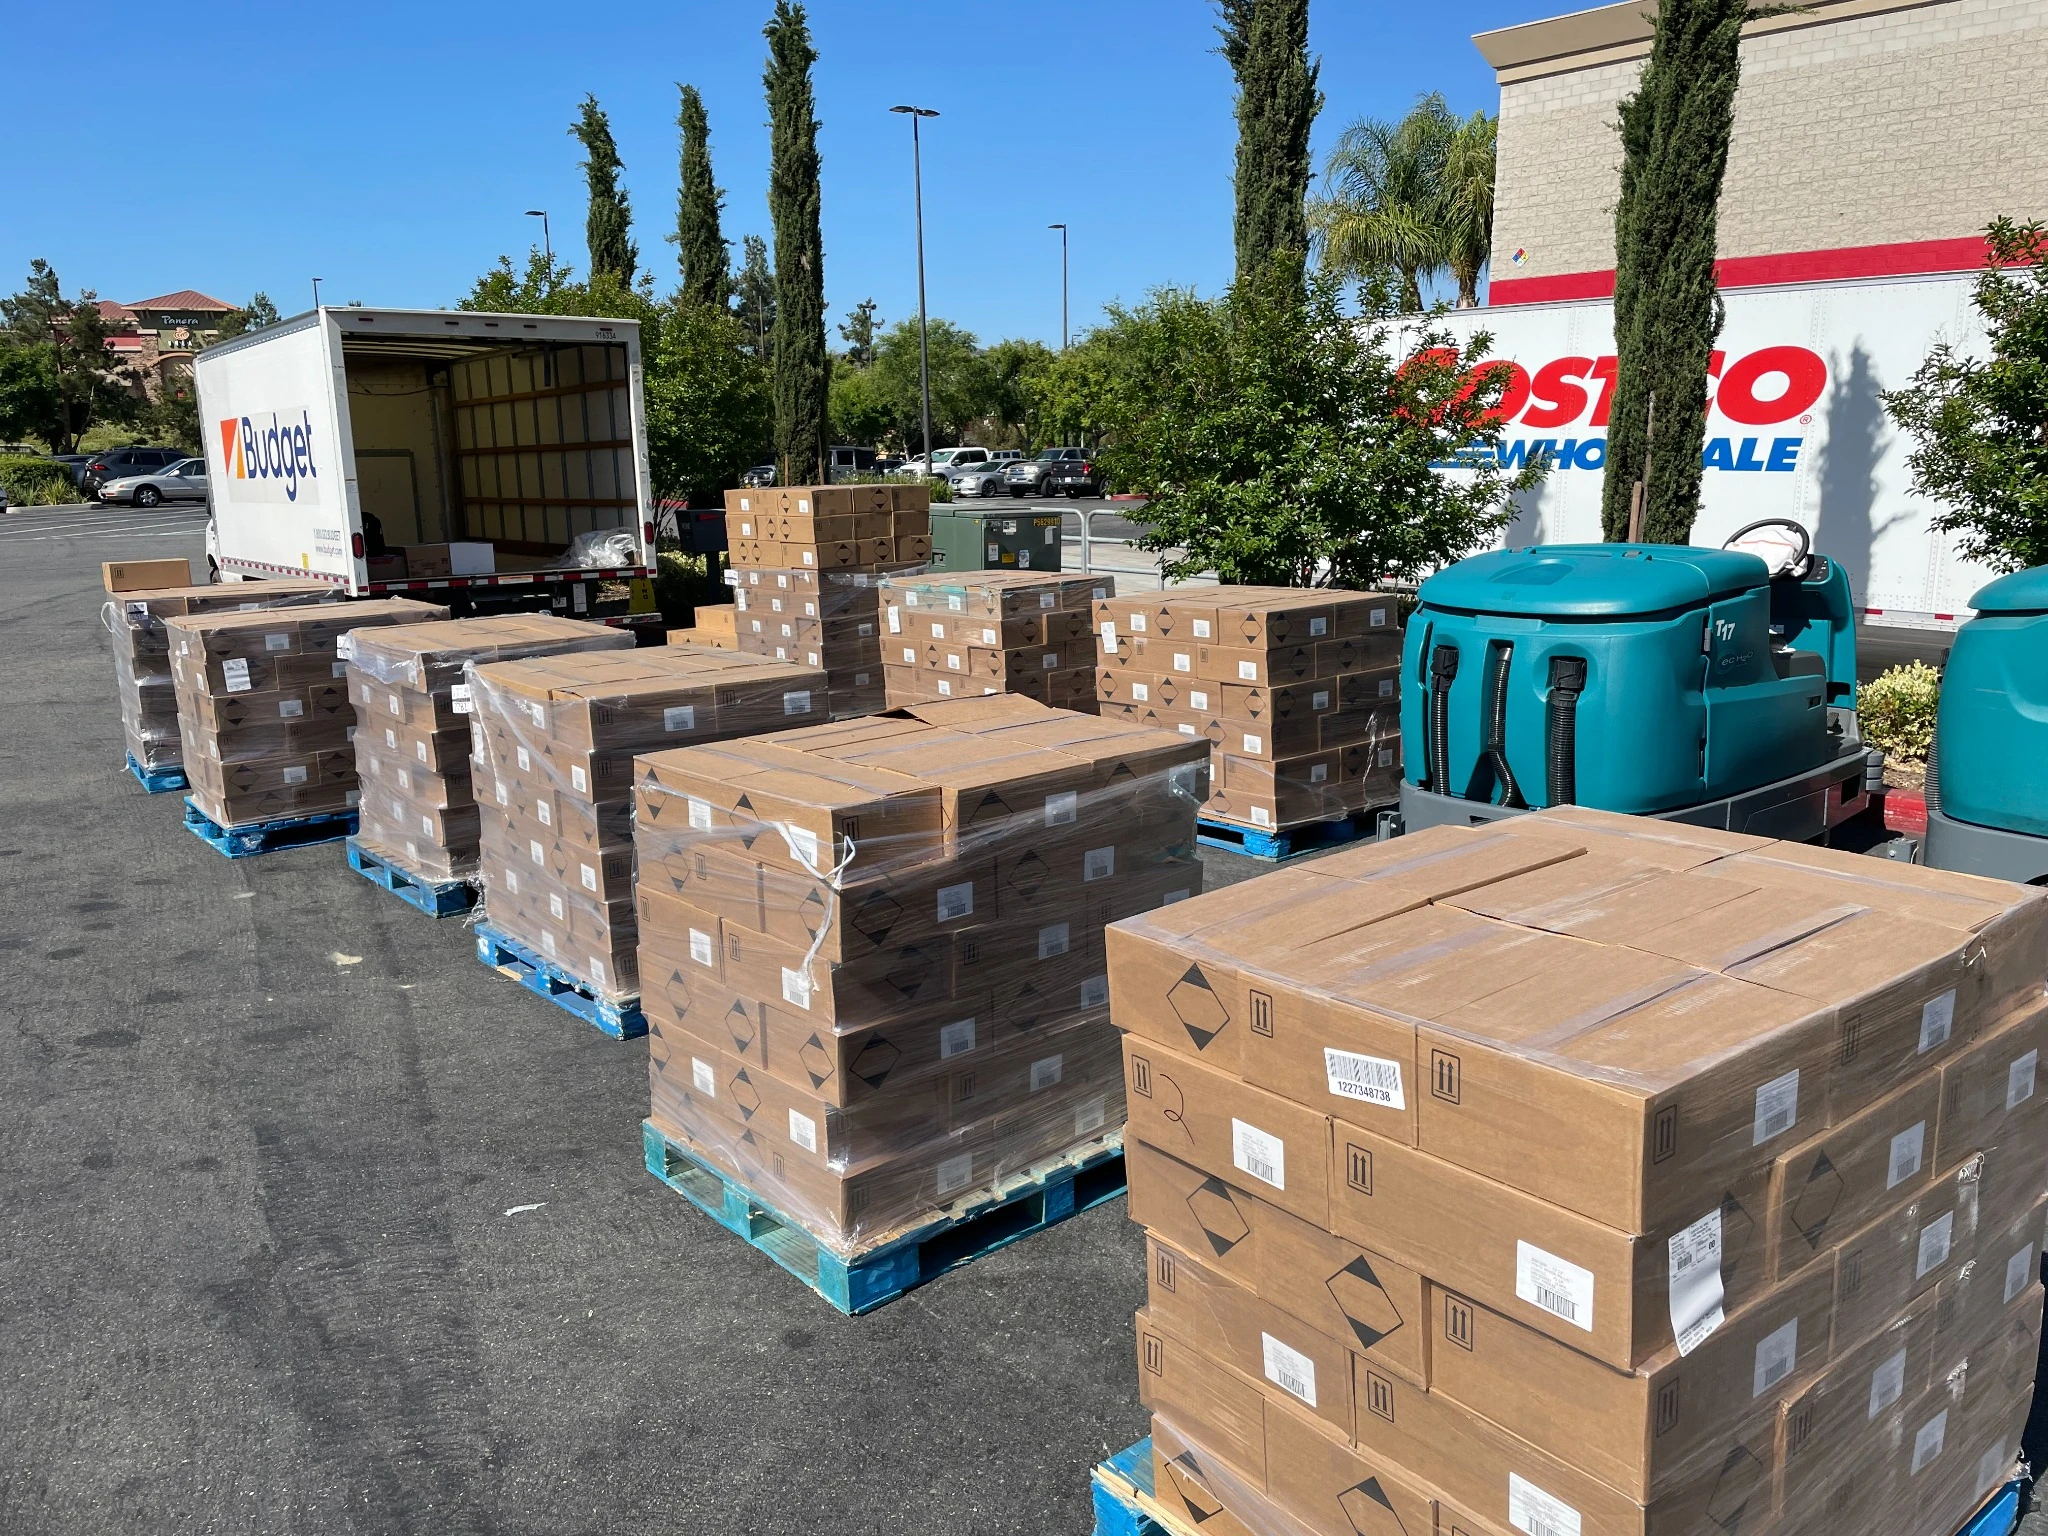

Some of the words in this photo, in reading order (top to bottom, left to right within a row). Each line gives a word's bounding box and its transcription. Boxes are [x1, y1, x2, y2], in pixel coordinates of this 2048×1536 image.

[161, 315, 199, 325] Panera
[1392, 345, 1828, 429] OSTO
[241, 409, 317, 502] Budget
[1496, 437, 1803, 472] WHOALE
[1715, 619, 1736, 641] T17
[1337, 1081, 1391, 1102] 1227348738
